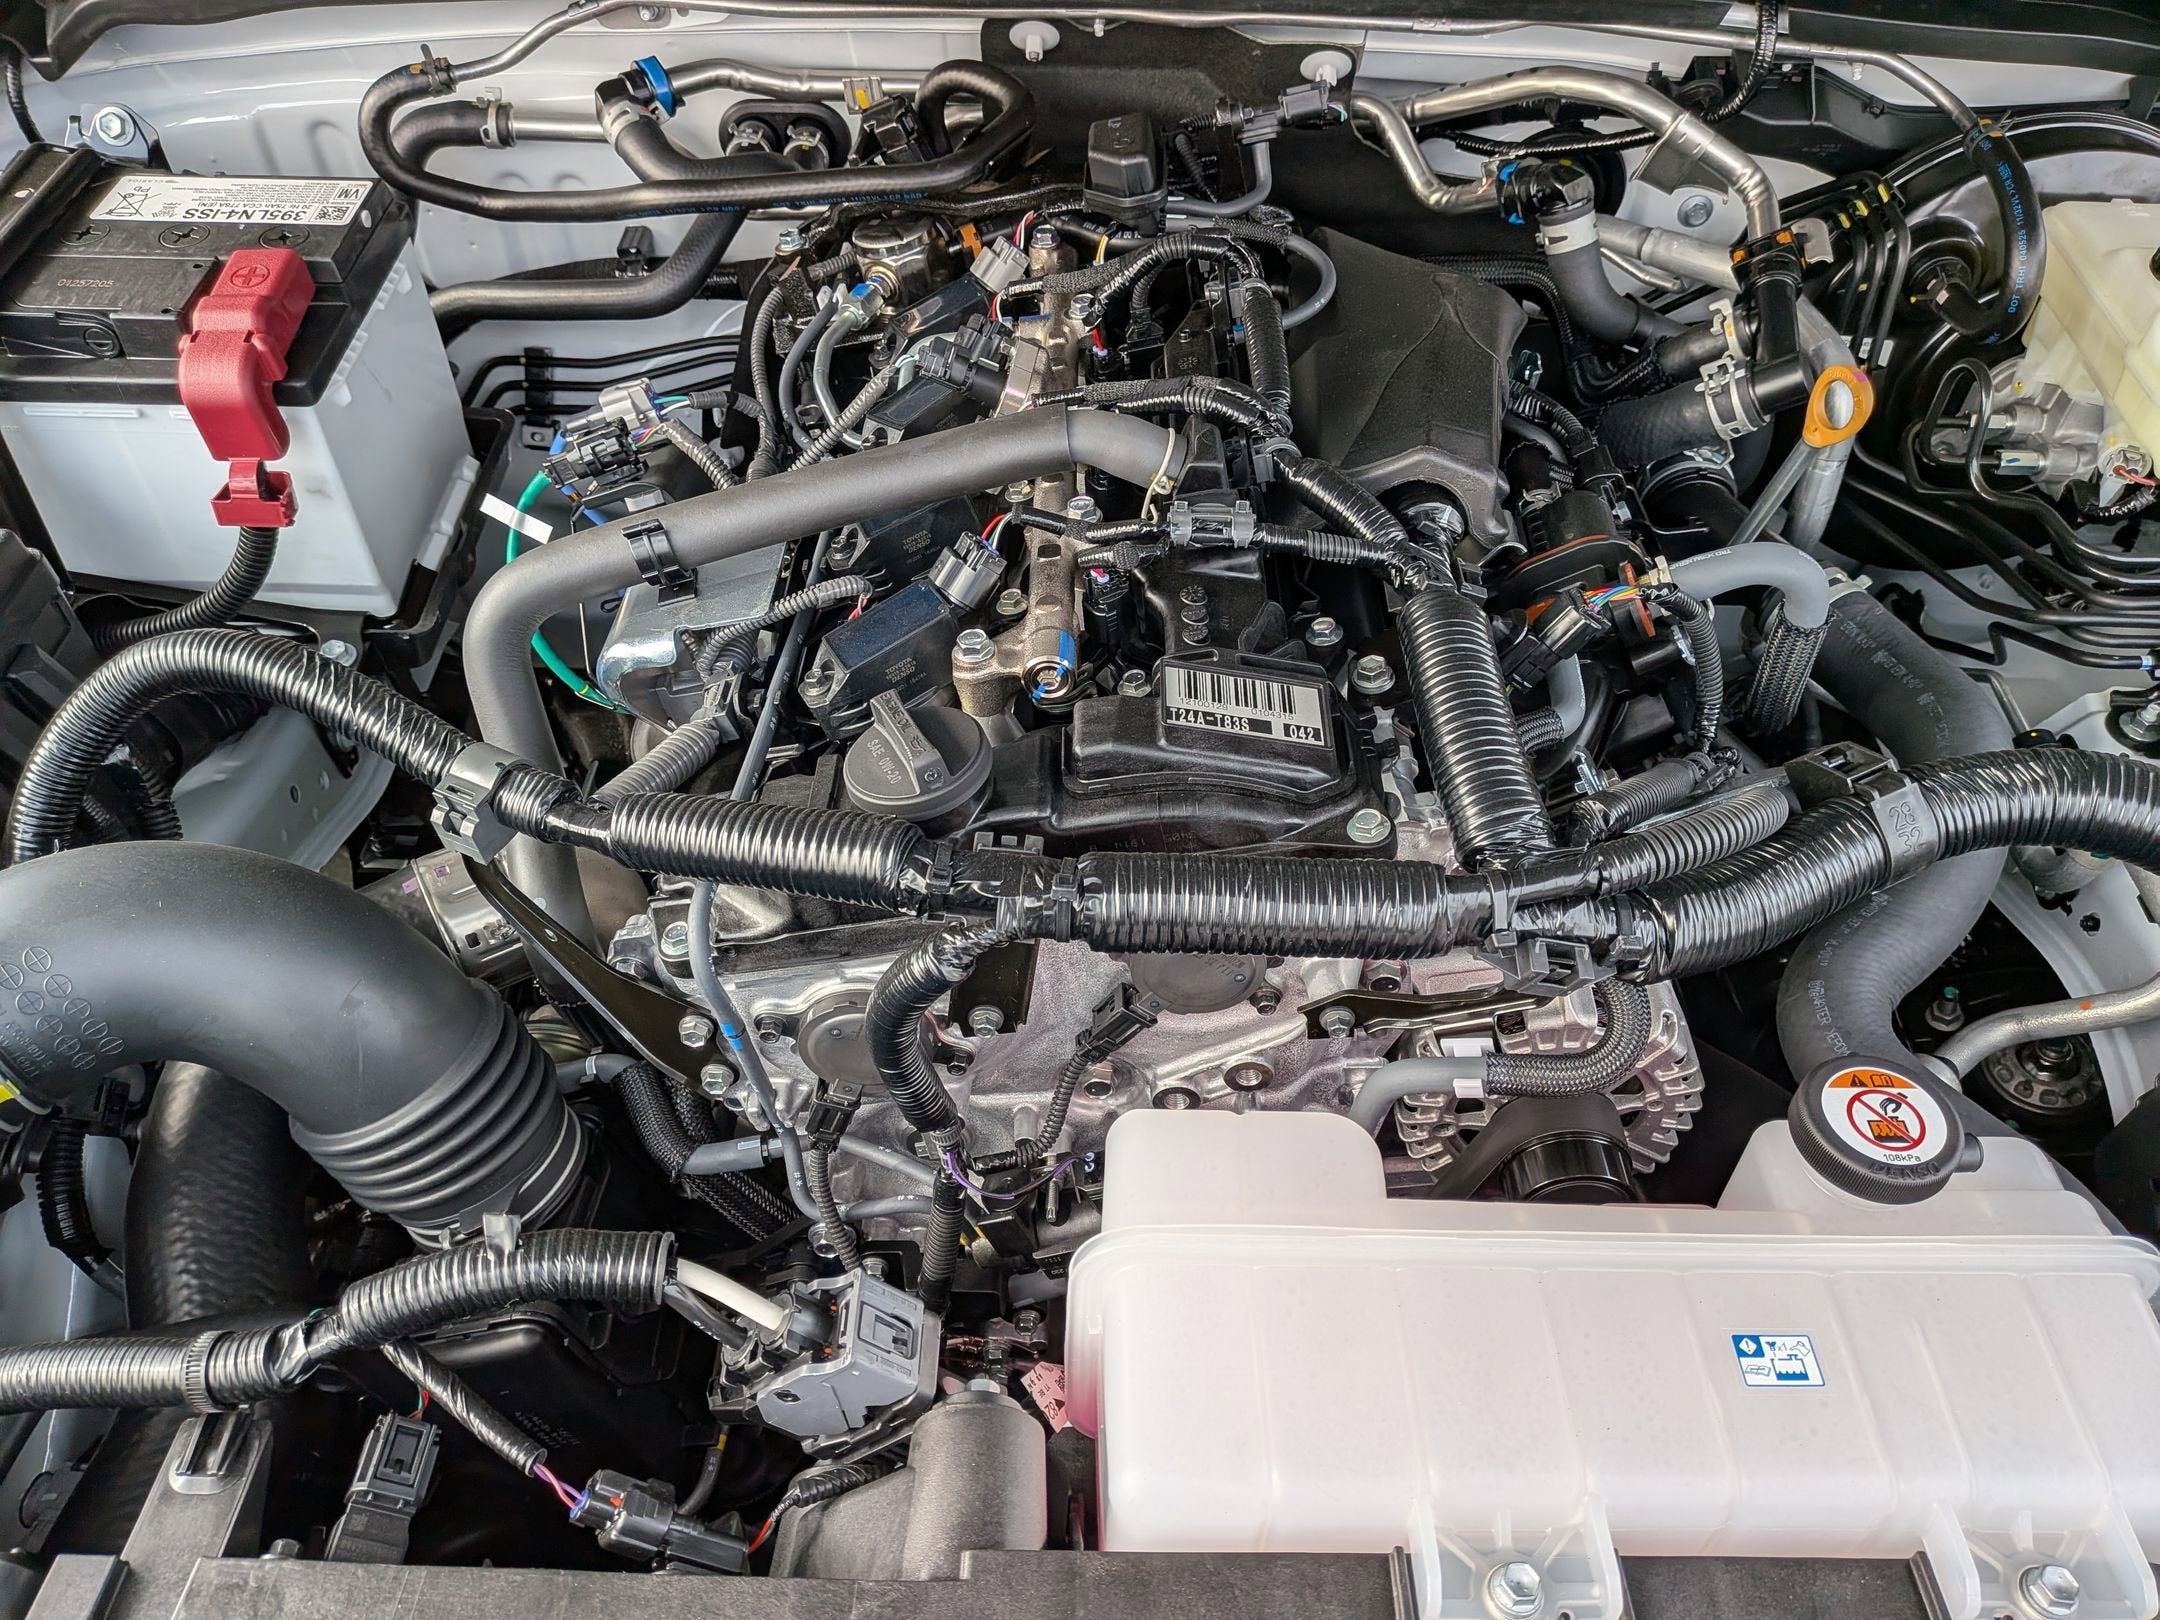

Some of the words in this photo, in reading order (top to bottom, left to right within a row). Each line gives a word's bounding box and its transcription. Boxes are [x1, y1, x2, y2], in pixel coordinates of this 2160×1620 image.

[133, 185, 152, 193] Pb
[338, 188, 361, 199] VM
[182, 207, 308, 221] 395LN4-ISS
[2008, 295, 2021, 313] DOT
[2018, 229, 2028, 261] 040525
[56, 278, 114, 289] 01257205
[902, 529, 929, 545] TOYOTA
[908, 538, 931, 554] DENSO
[884, 657, 913, 674] TOYOTA
[891, 665, 916, 683] DENSO
[1250, 708, 1294, 721] 0104315
[1170, 707, 1250, 732] T24A-T83S
[1289, 725, 1314, 741] 042
[866, 739, 886, 757] SAE
[878, 757, 902, 785] 0W-20
[1888, 801, 1917, 832] 28
[1883, 1153, 1921, 1162] 108kPa
[1871, 1160, 1941, 1180] DENSO
